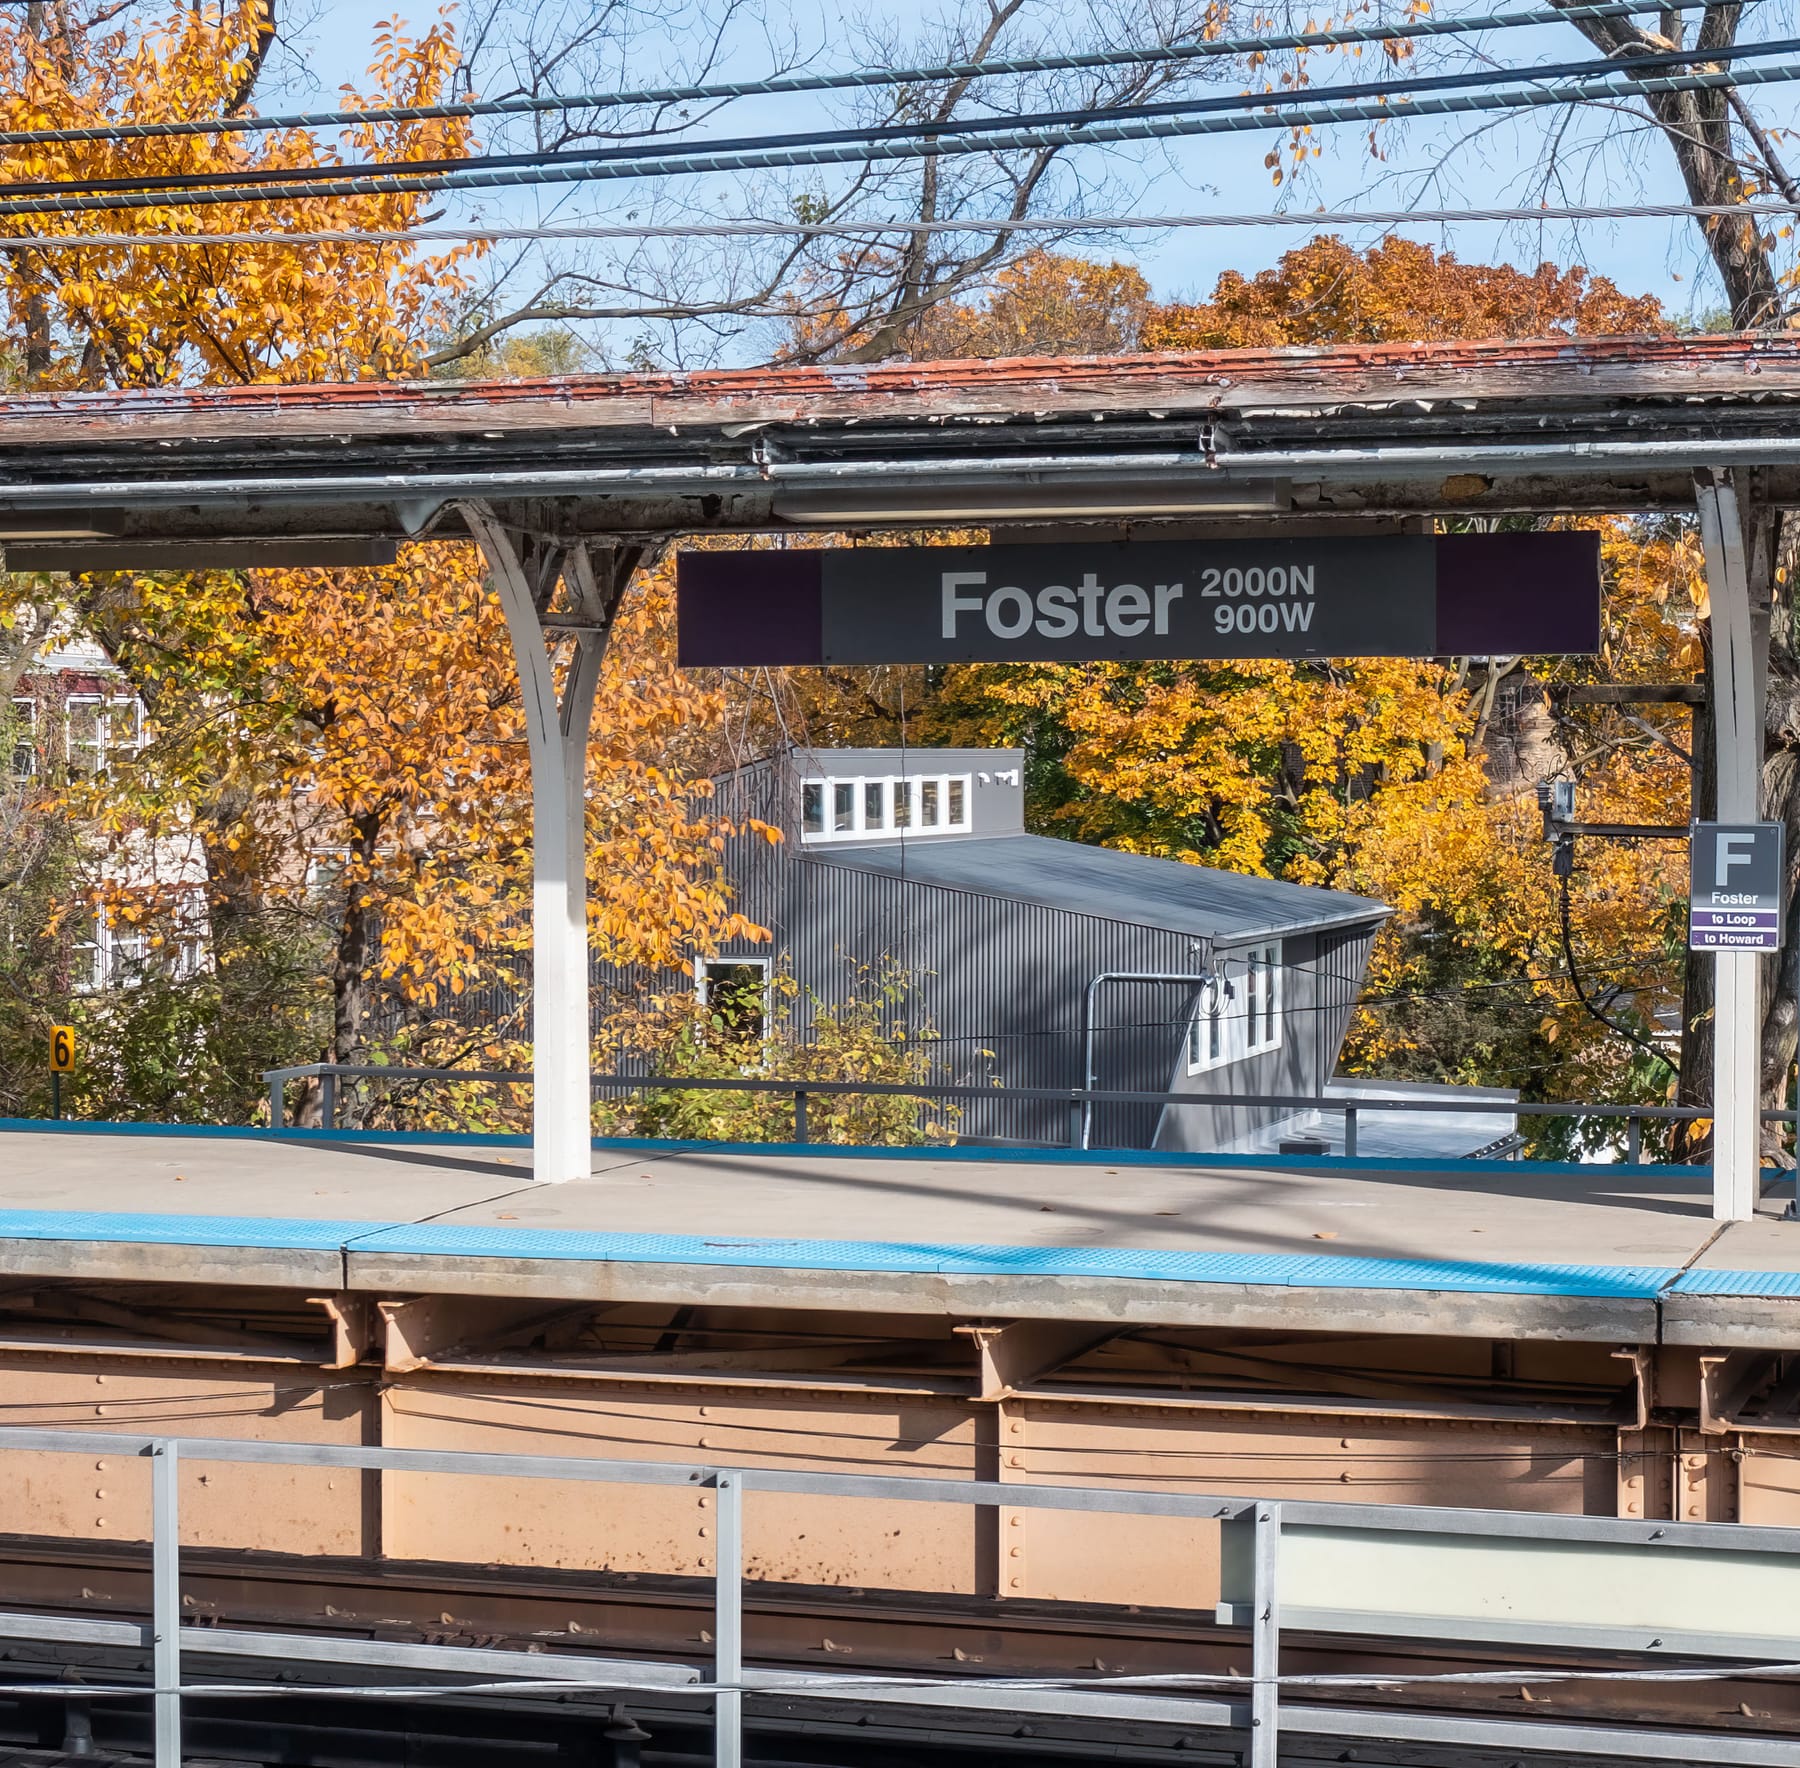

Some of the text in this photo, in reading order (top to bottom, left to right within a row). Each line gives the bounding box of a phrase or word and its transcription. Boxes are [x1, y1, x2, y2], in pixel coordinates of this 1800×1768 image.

[1201, 565, 1314, 597] 2000N
[941, 571, 1183, 639] Foster
[1214, 602, 1315, 634] 900W
[1716, 832, 1755, 886] F
[1711, 891, 1759, 905] Foster
[1711, 913, 1757, 926] to Loop
[1704, 933, 1764, 944] to Howard
[54, 1030, 70, 1067] 6
